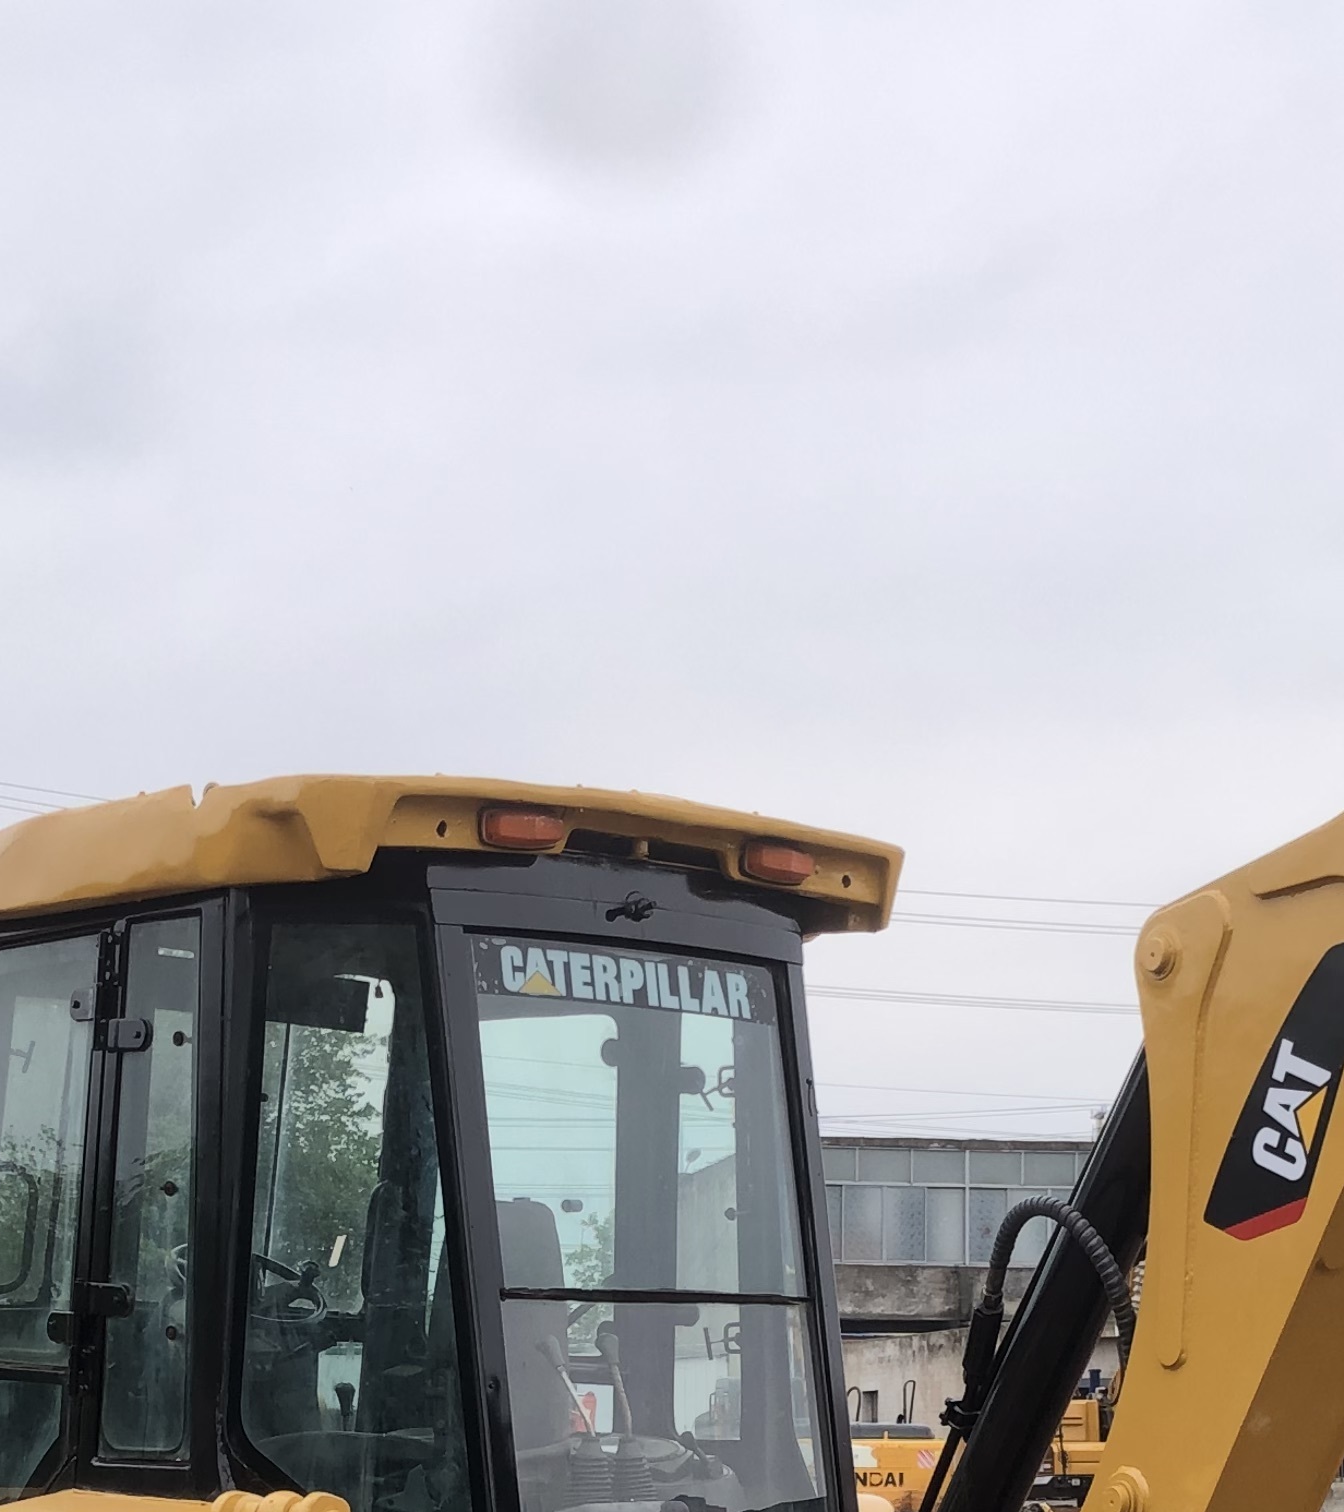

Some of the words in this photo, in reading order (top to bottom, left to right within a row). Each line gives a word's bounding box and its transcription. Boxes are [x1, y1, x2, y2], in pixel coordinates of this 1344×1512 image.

[500, 945, 752, 1020] CATERPILLAR
[1252, 1038, 1332, 1182] CAT
[856, 1472, 904, 1487] NDAI
